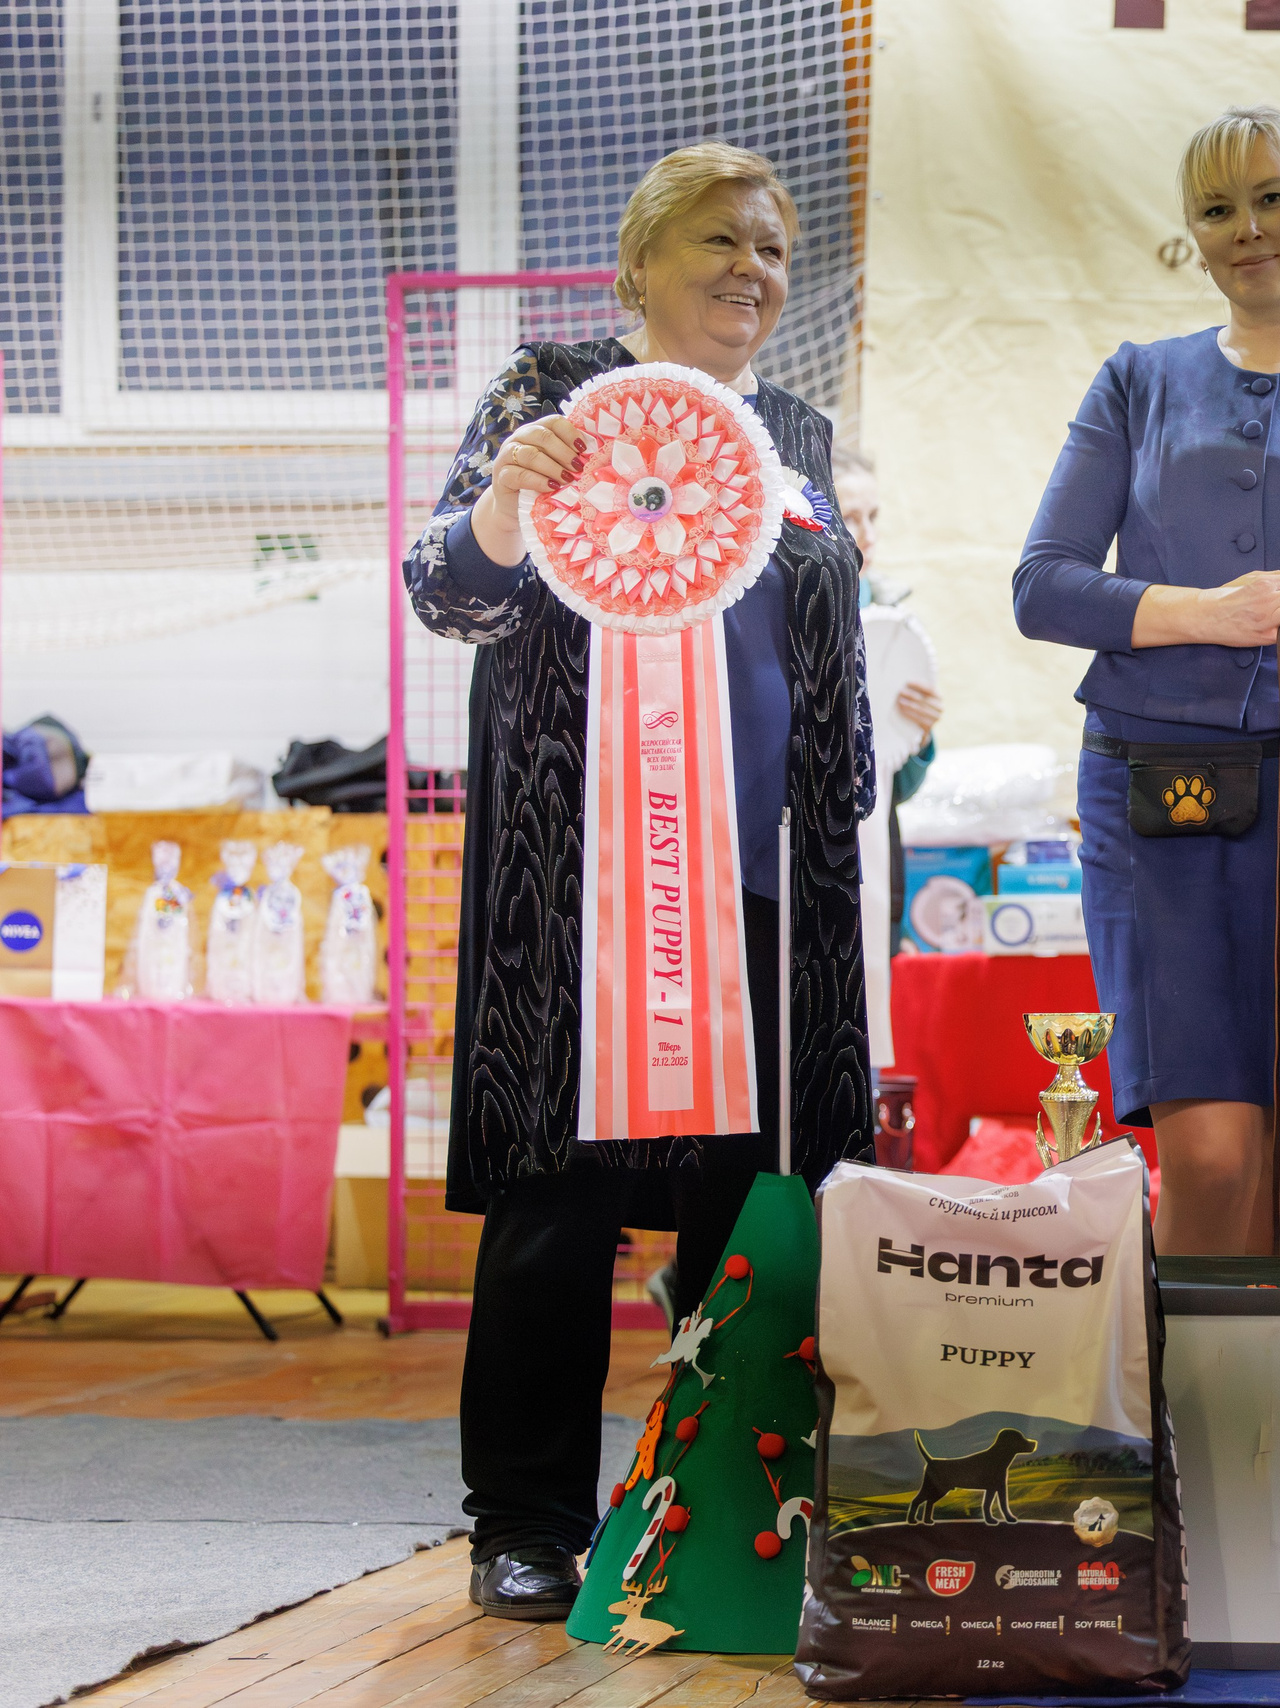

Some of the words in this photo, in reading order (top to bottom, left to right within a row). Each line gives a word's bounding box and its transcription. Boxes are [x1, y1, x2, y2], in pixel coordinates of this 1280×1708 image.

[648, 788, 680, 875] BEST
[651, 879, 683, 988] PUPPY
[653, 1012, 684, 1026] 1
[658, 1041, 682, 1053] Тверь
[651, 1056, 689, 1067] 21.12.2025
[929, 1196, 939, 1207] с
[1001, 1208, 1011, 1221] и
[1012, 1203, 1059, 1223] рисом
[877, 1236, 1105, 1289] Hanta
[944, 1292, 1035, 1308] premium
[939, 1343, 1037, 1369] PUPPY
[935, 1566, 966, 1577] FRESH
[1077, 1569, 1107, 1577] NATURAL
[935, 1578, 961, 1589] MEAT
[1009, 1577, 1059, 1586] GLUCOSAMINE
[1077, 1577, 1119, 1586] INGREDIENTS
[852, 1617, 891, 1627] BALANCE
[910, 1620, 944, 1629] OMEGA
[961, 1621, 995, 1629] OMEGA
[1011, 1621, 1033, 1629] GMO
[1034, 1621, 1058, 1629] FREE
[1074, 1620, 1093, 1628] SOY
[1094, 1620, 1117, 1628] FREE
[977, 1659, 991, 1669] 12
